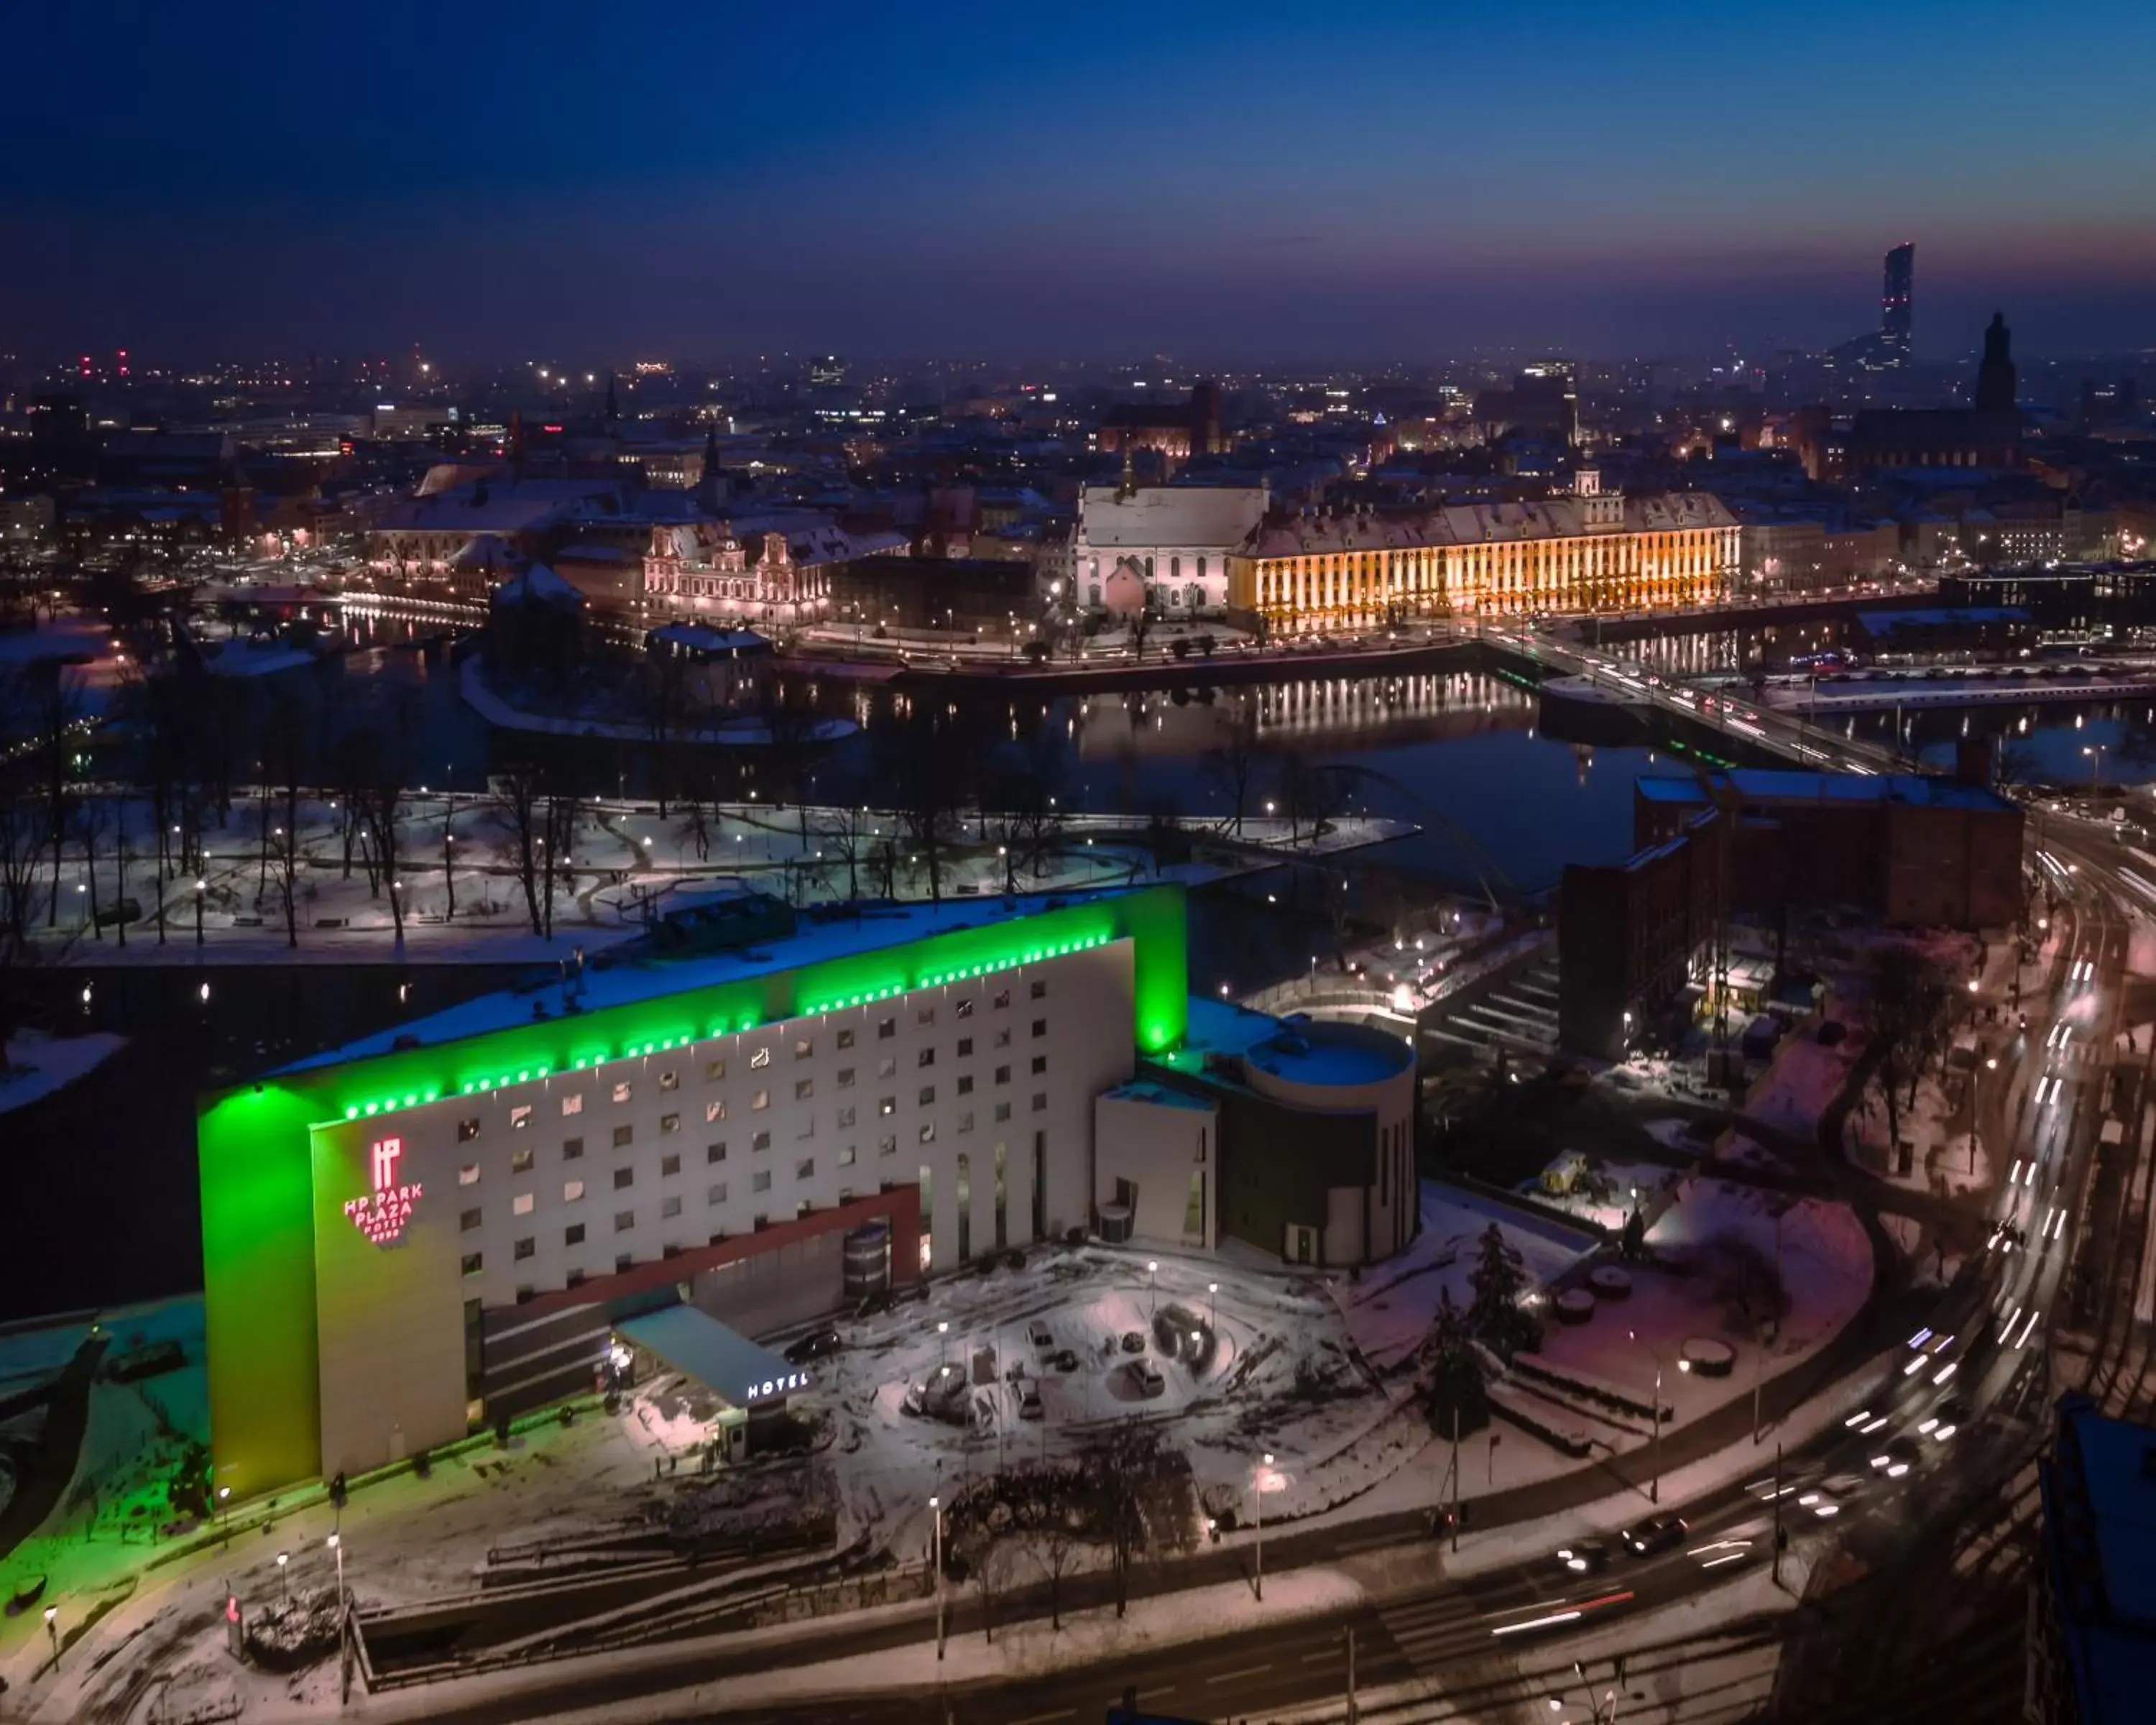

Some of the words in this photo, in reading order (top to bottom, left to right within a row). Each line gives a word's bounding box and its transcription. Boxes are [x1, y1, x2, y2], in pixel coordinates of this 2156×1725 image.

[344, 1196, 369, 1215] HP
[376, 1182, 423, 1207] PARK
[355, 1201, 412, 1228] PLAZA
[364, 1217, 405, 1235] HOTEL
[748, 1372, 808, 1399] HOTEL
